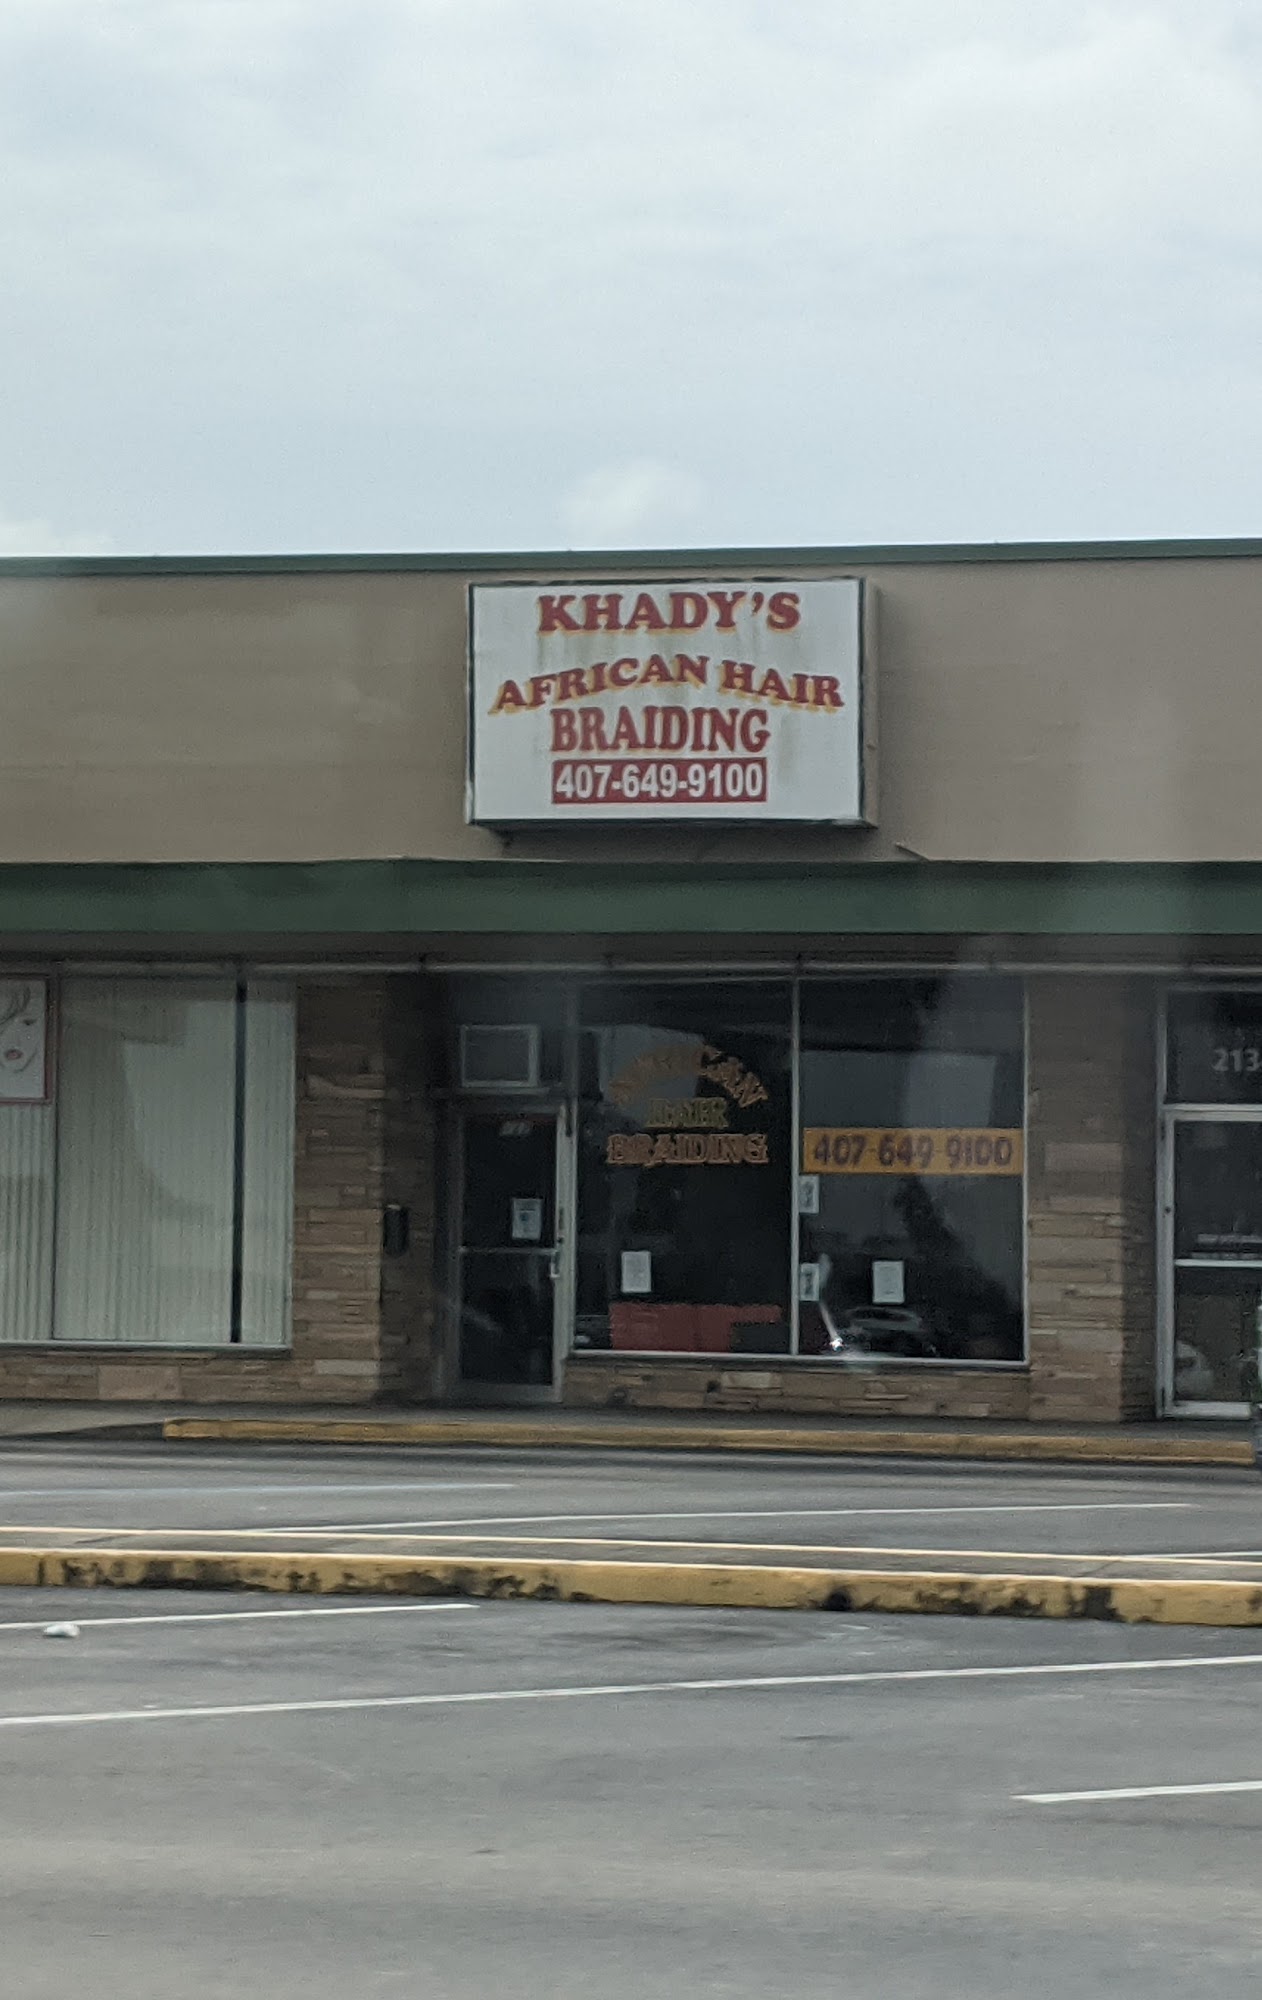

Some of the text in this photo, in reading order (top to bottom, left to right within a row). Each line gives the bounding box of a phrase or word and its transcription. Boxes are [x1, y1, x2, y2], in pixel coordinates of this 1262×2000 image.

[537, 591, 801, 635] KHADY'S
[488, 653, 845, 715] AFRICAN HAIR
[550, 705, 771, 752] BRAIDING
[555, 763, 763, 799] 407-649-9100
[1210, 1047, 1262, 1072] 213
[606, 1133, 769, 1168] BRAIDING
